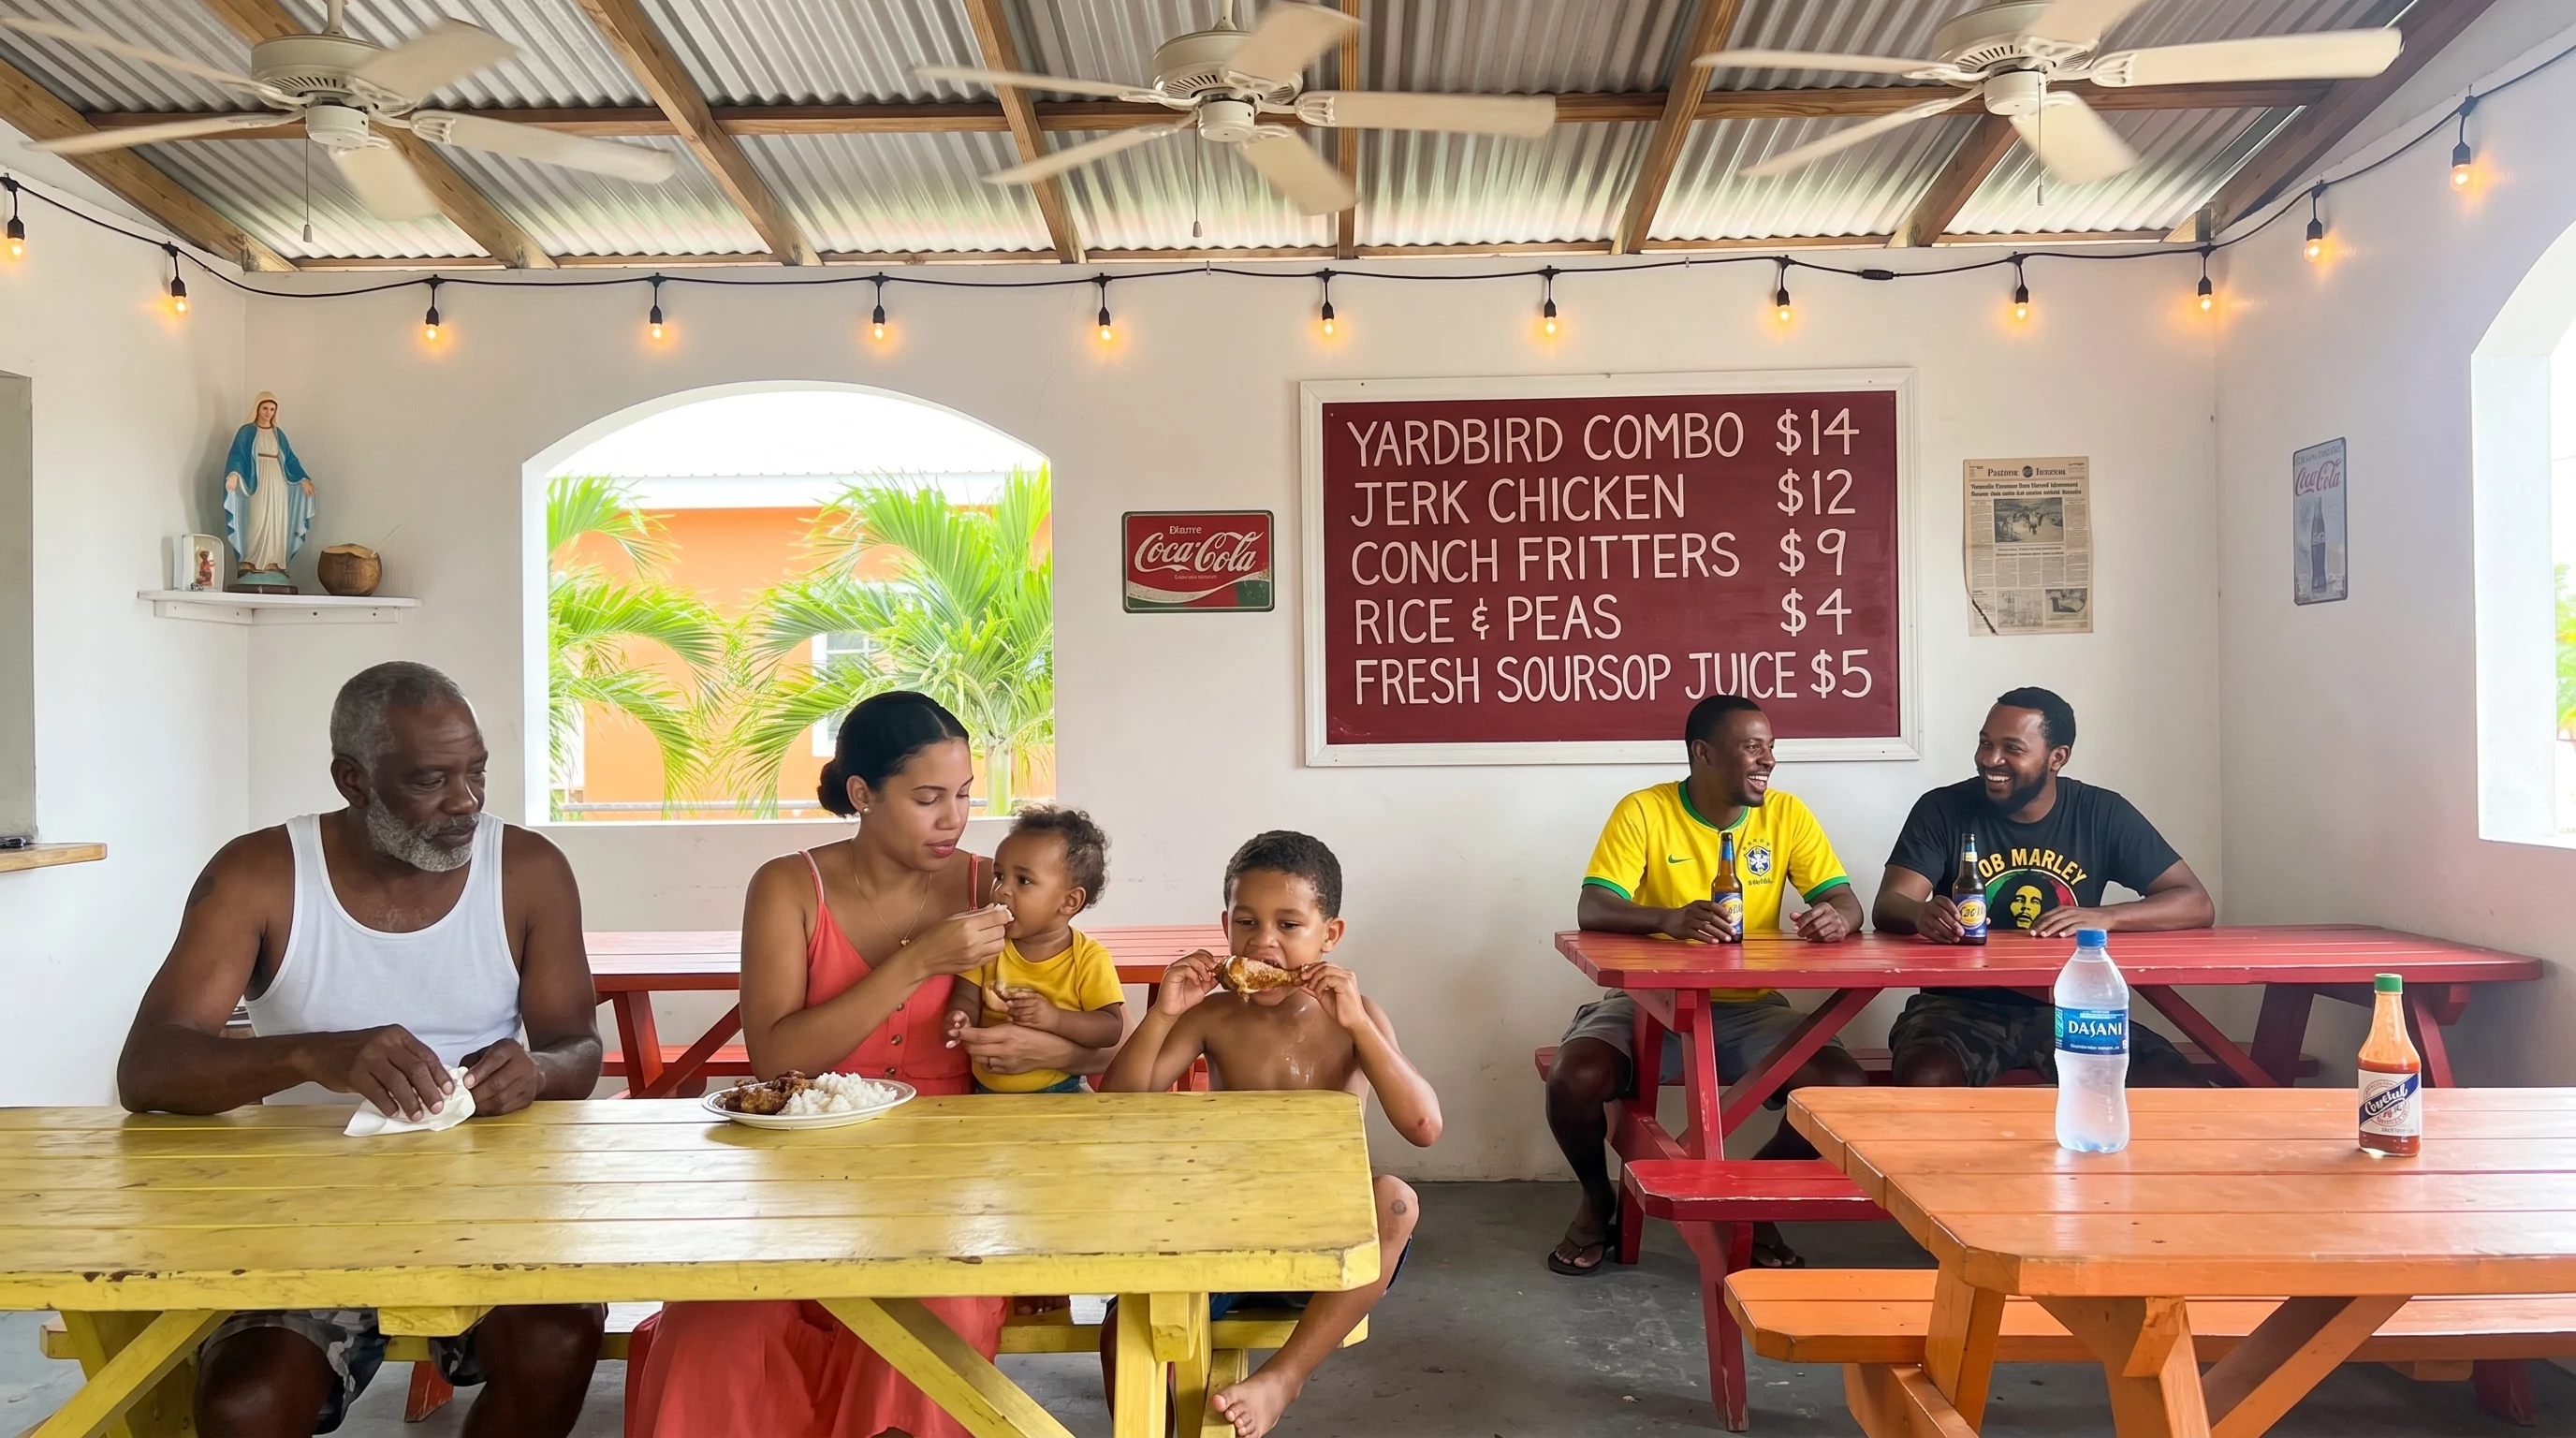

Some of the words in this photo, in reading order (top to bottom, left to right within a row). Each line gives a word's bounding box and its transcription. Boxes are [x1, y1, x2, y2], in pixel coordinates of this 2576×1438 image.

[1347, 418, 1562, 466] YARDBIRD
[1585, 412, 1743, 460] COMBO
[1777, 408, 1859, 456] $14
[1352, 480, 1470, 526] JERK
[1489, 474, 1684, 522] CHICKEN
[1778, 469, 1855, 516] $12
[1134, 531, 1265, 573] Coca-Cola
[1353, 539, 1498, 586] CONCH
[1519, 533, 1740, 580] FRITTERS
[1356, 599, 1455, 645] RICE
[1472, 598, 1490, 640] &
[1508, 594, 1621, 641] PEAS
[1356, 658, 1480, 706] FRESH
[1498, 654, 1671, 703] SOURSOP
[1686, 652, 1797, 699] JUICE
[1810, 649, 1872, 699] $5
[1978, 853, 2006, 878] OB
[2011, 848, 2088, 886] MARLEY
[2068, 1020, 2122, 1038] DASANI
